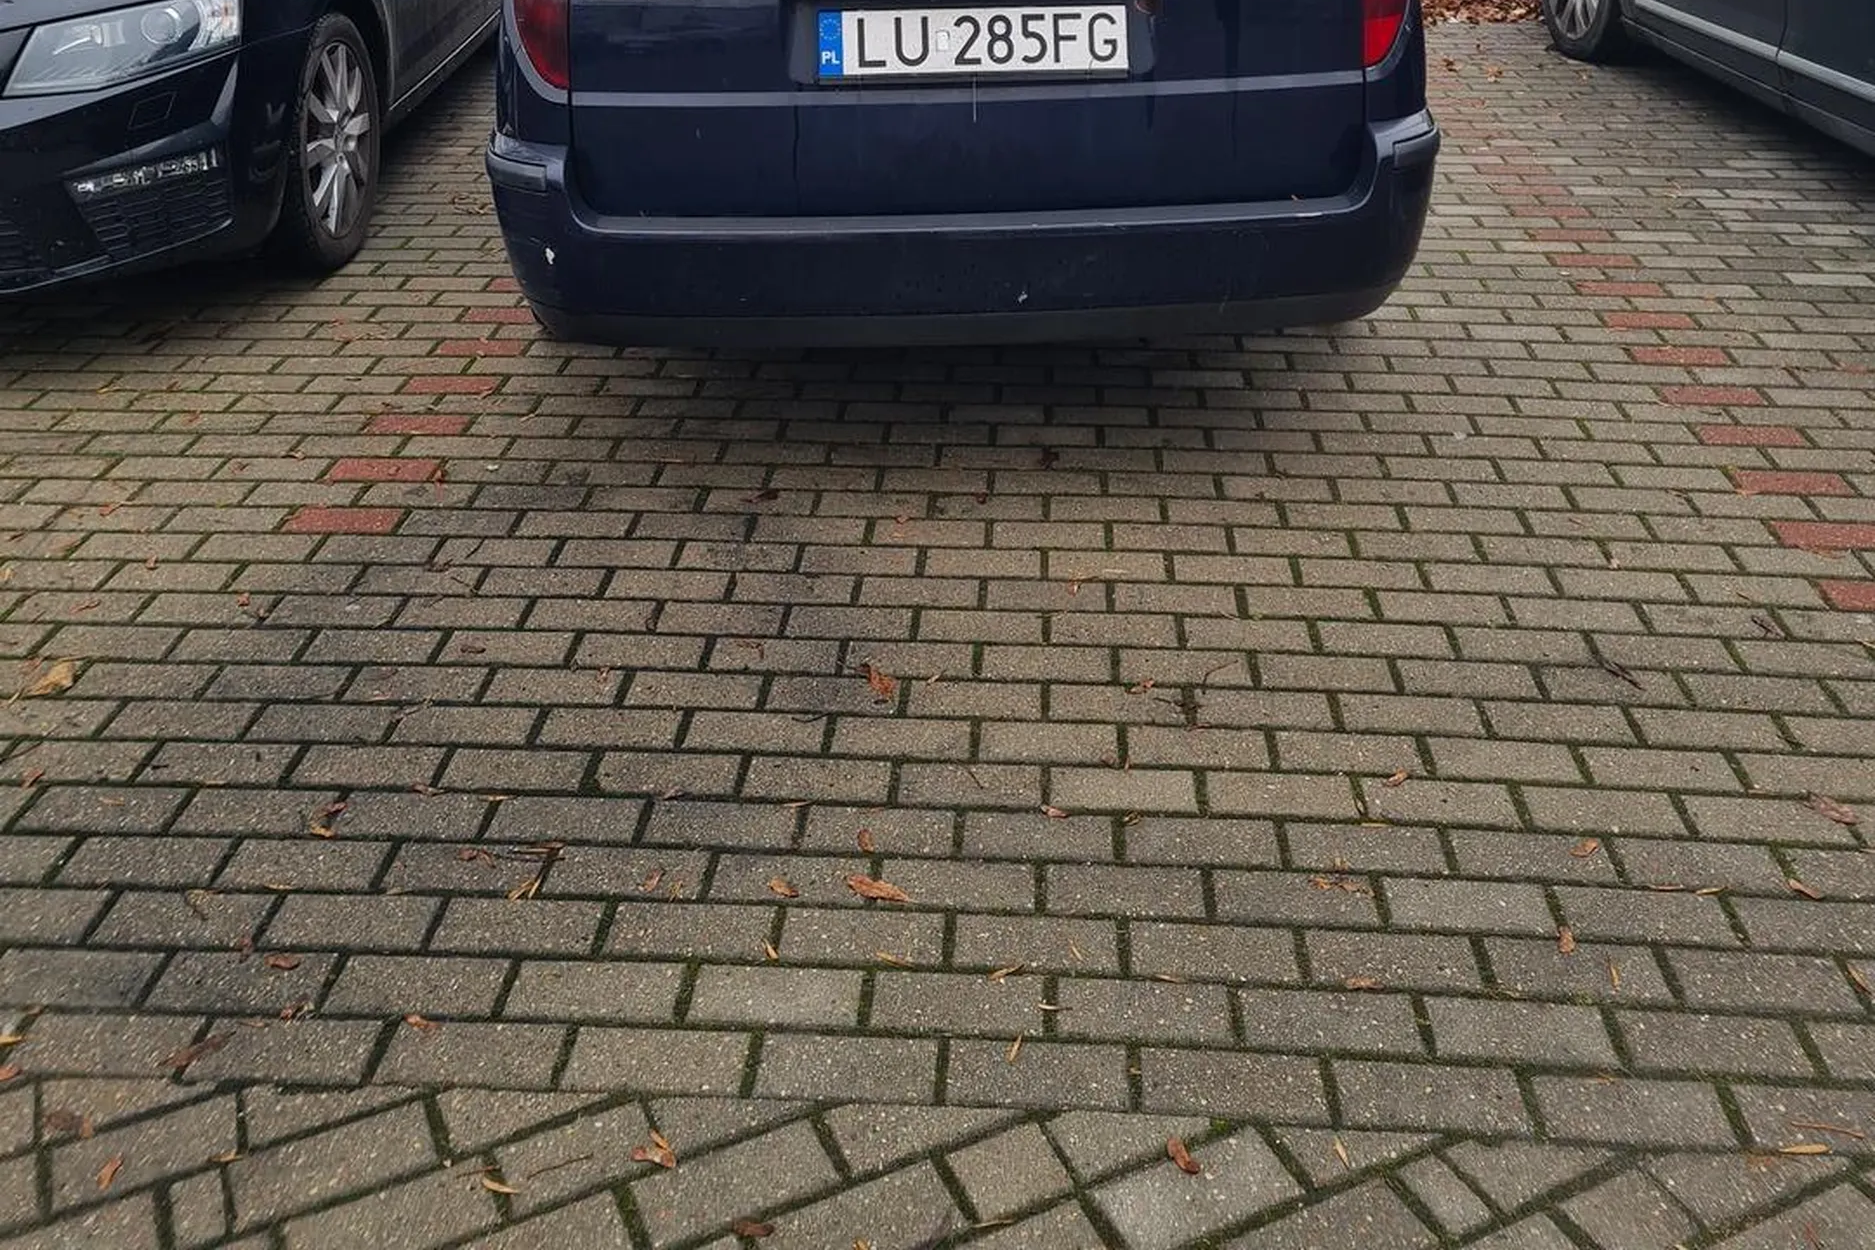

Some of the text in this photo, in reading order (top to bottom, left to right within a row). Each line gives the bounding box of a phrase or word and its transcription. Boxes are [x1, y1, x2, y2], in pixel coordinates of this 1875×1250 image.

[856, 12, 1118, 68] LU 285FG
[821, 51, 840, 66] PL
